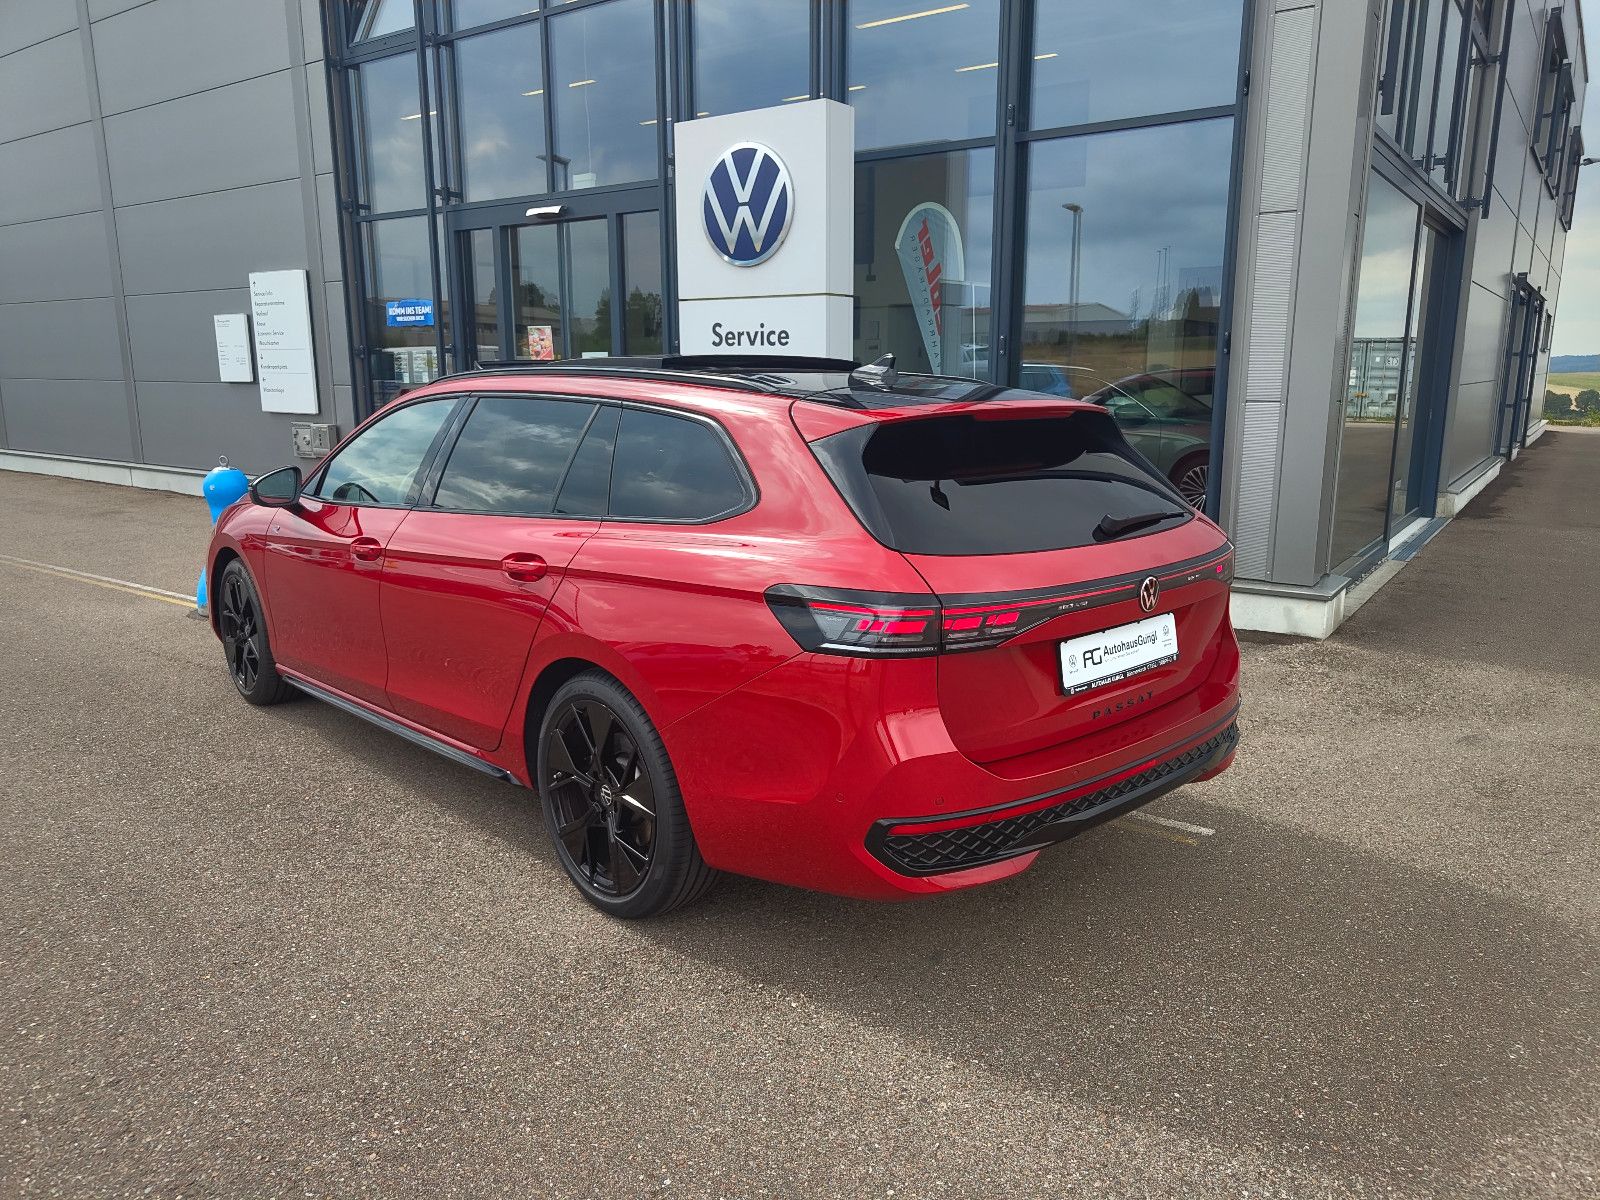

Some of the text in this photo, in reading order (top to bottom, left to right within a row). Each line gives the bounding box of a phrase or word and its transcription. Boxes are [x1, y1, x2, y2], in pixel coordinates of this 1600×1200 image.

[711, 322, 790, 347] Service
[1103, 630, 1158, 657] AutohausGungl
[1092, 690, 1153, 720] PASSAT
